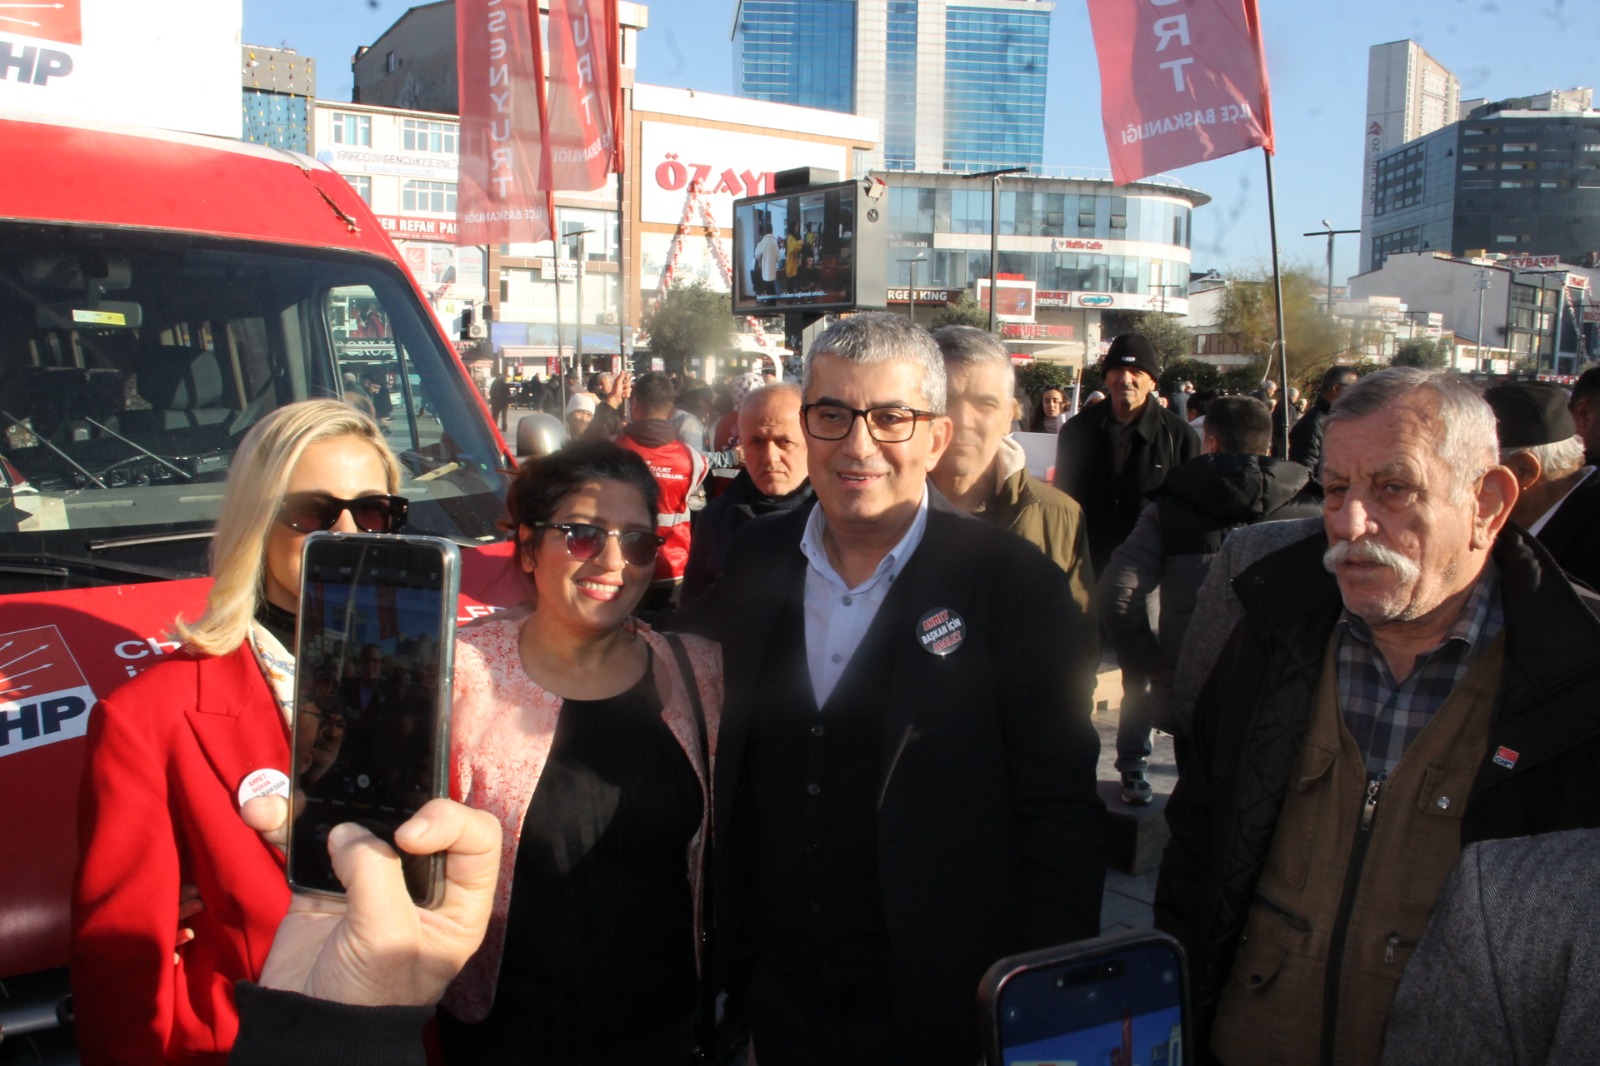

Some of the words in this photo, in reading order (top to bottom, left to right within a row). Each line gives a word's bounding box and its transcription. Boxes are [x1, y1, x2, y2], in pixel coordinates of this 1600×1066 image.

[399, 218, 434, 233] REFAH
[919, 291, 948, 301] KING
[921, 625, 948, 645] BAŞKAN
[945, 617, 962, 631] İÇİN
